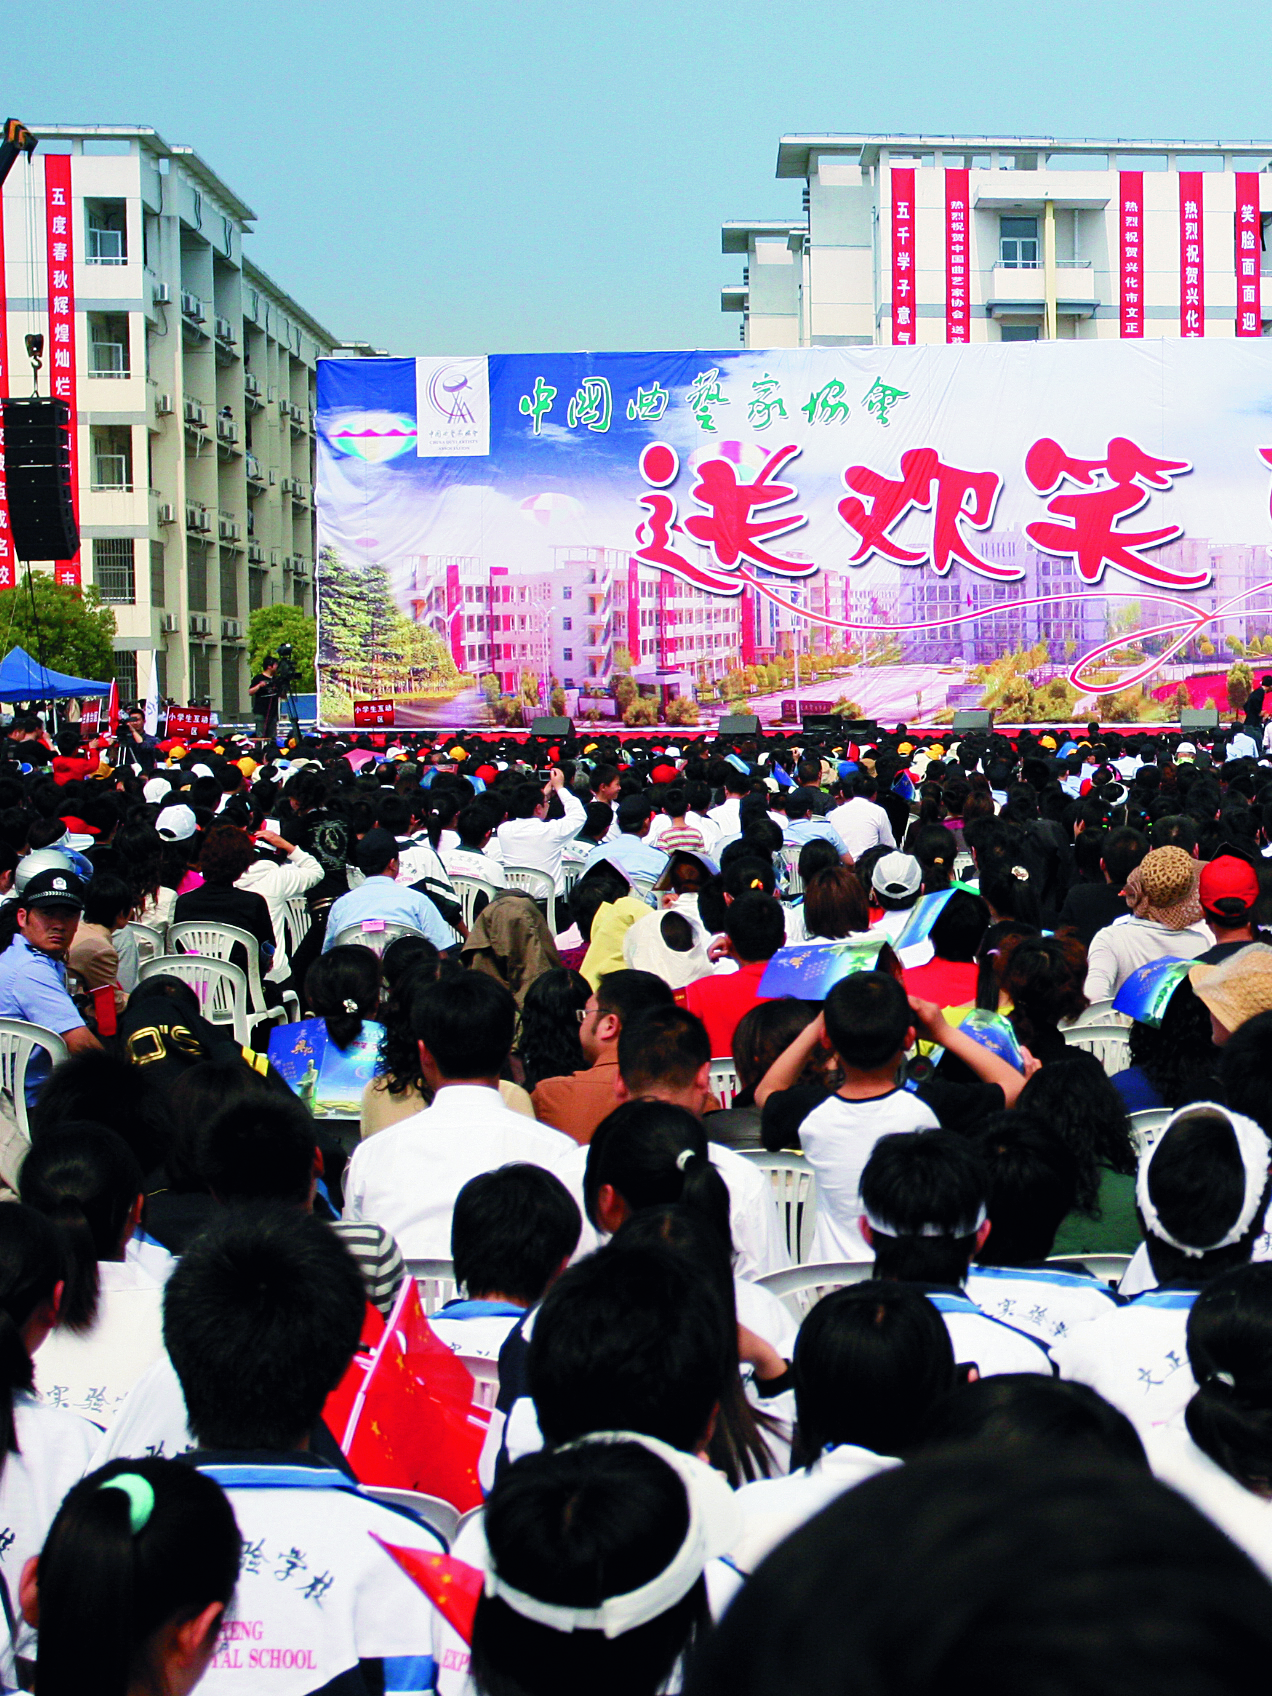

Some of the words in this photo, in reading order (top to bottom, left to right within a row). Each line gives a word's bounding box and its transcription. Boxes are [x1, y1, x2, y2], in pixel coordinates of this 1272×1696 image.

[896, 202, 911, 345] 五千学子意气
[1125, 201, 1139, 333] 热烈祝贺兴化市文正
[1241, 204, 1257, 331] 笑脸面面迎
[249, 1648, 318, 1670] SCHOOL
